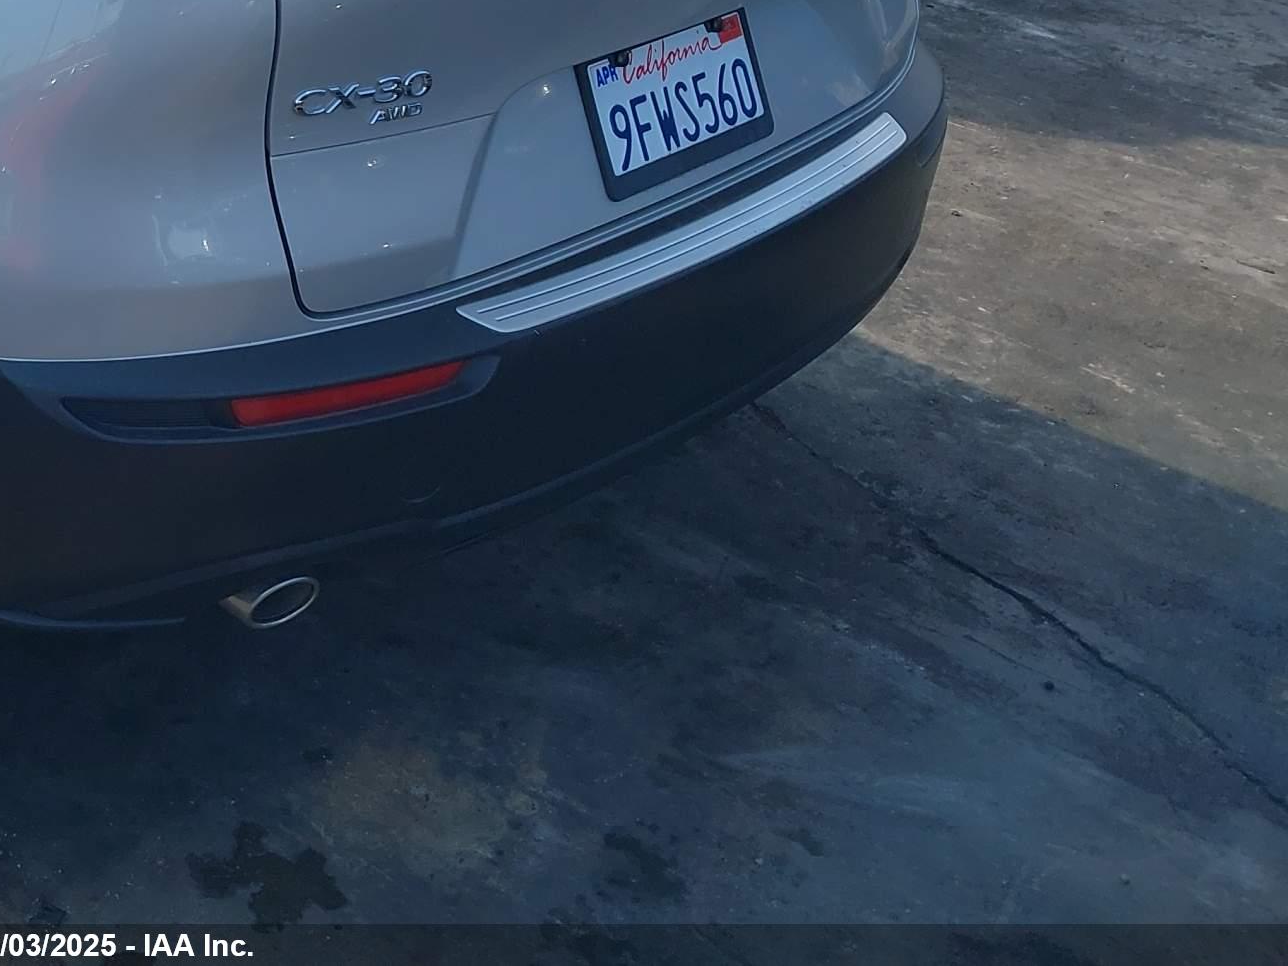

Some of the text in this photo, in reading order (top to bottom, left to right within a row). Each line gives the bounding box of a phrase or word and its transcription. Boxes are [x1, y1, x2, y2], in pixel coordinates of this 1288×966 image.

[622, 31, 723, 82] California
[294, 69, 433, 115] CX-30
[368, 103, 423, 125] AWD
[609, 58, 757, 171] 9FWS560
